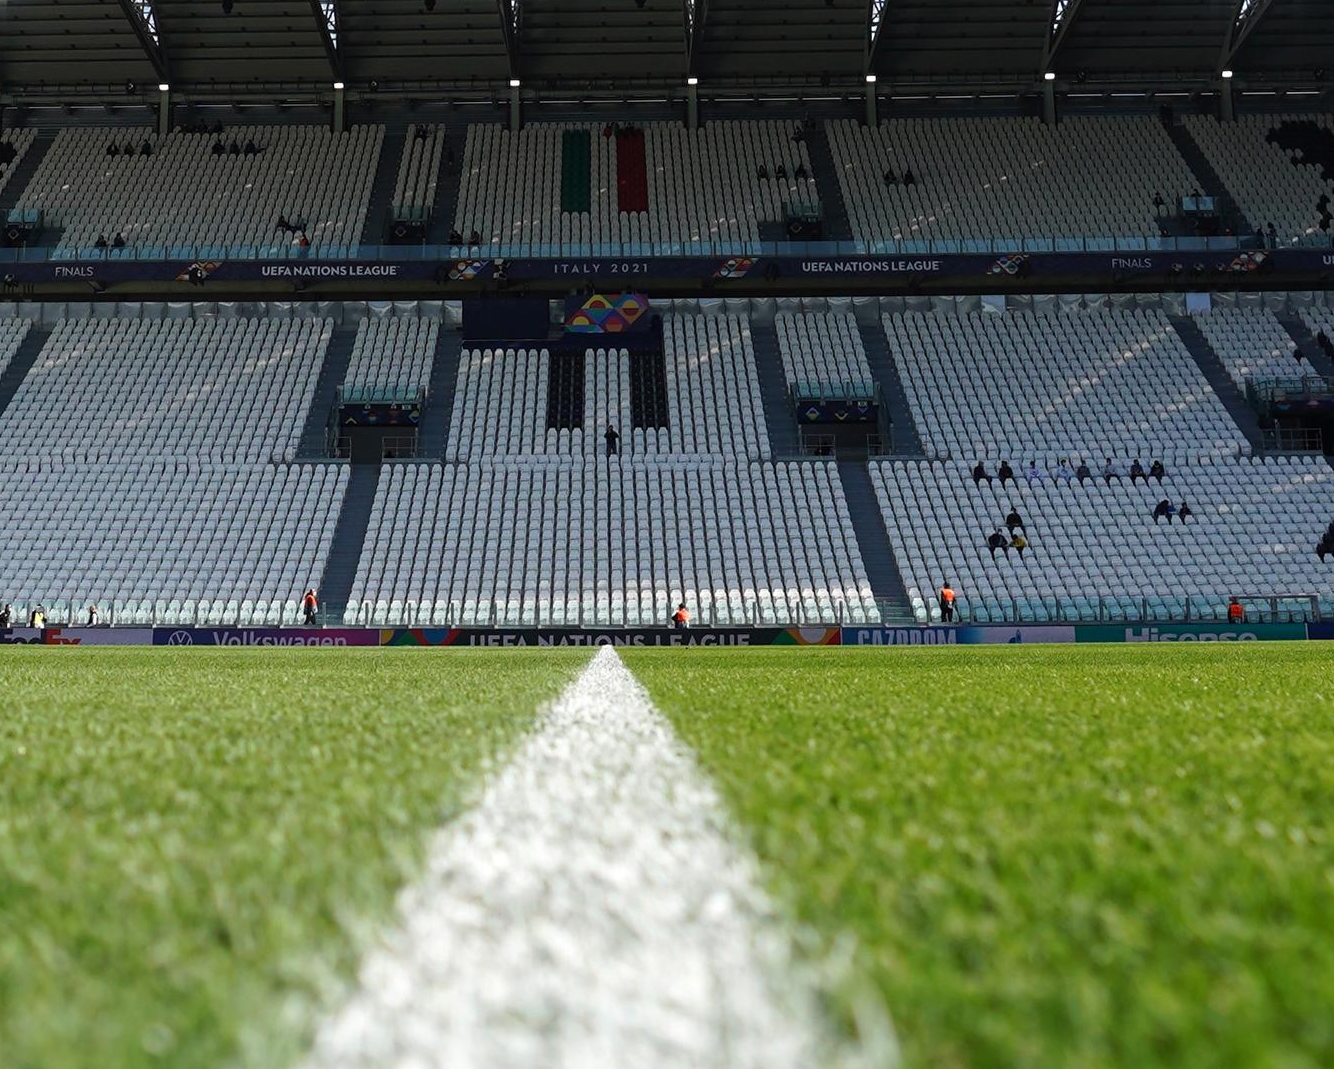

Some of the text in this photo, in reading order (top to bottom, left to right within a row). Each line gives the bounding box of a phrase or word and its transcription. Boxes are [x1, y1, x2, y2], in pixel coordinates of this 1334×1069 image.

[554, 263, 649, 274] ITALY 2021
[802, 261, 940, 272] UEFA NATIONS LEAGUE
[1111, 257, 1152, 269] FINALS
[55, 266, 94, 277] FINALS
[261, 265, 397, 276] UEFA NATIONS LEAGUE
